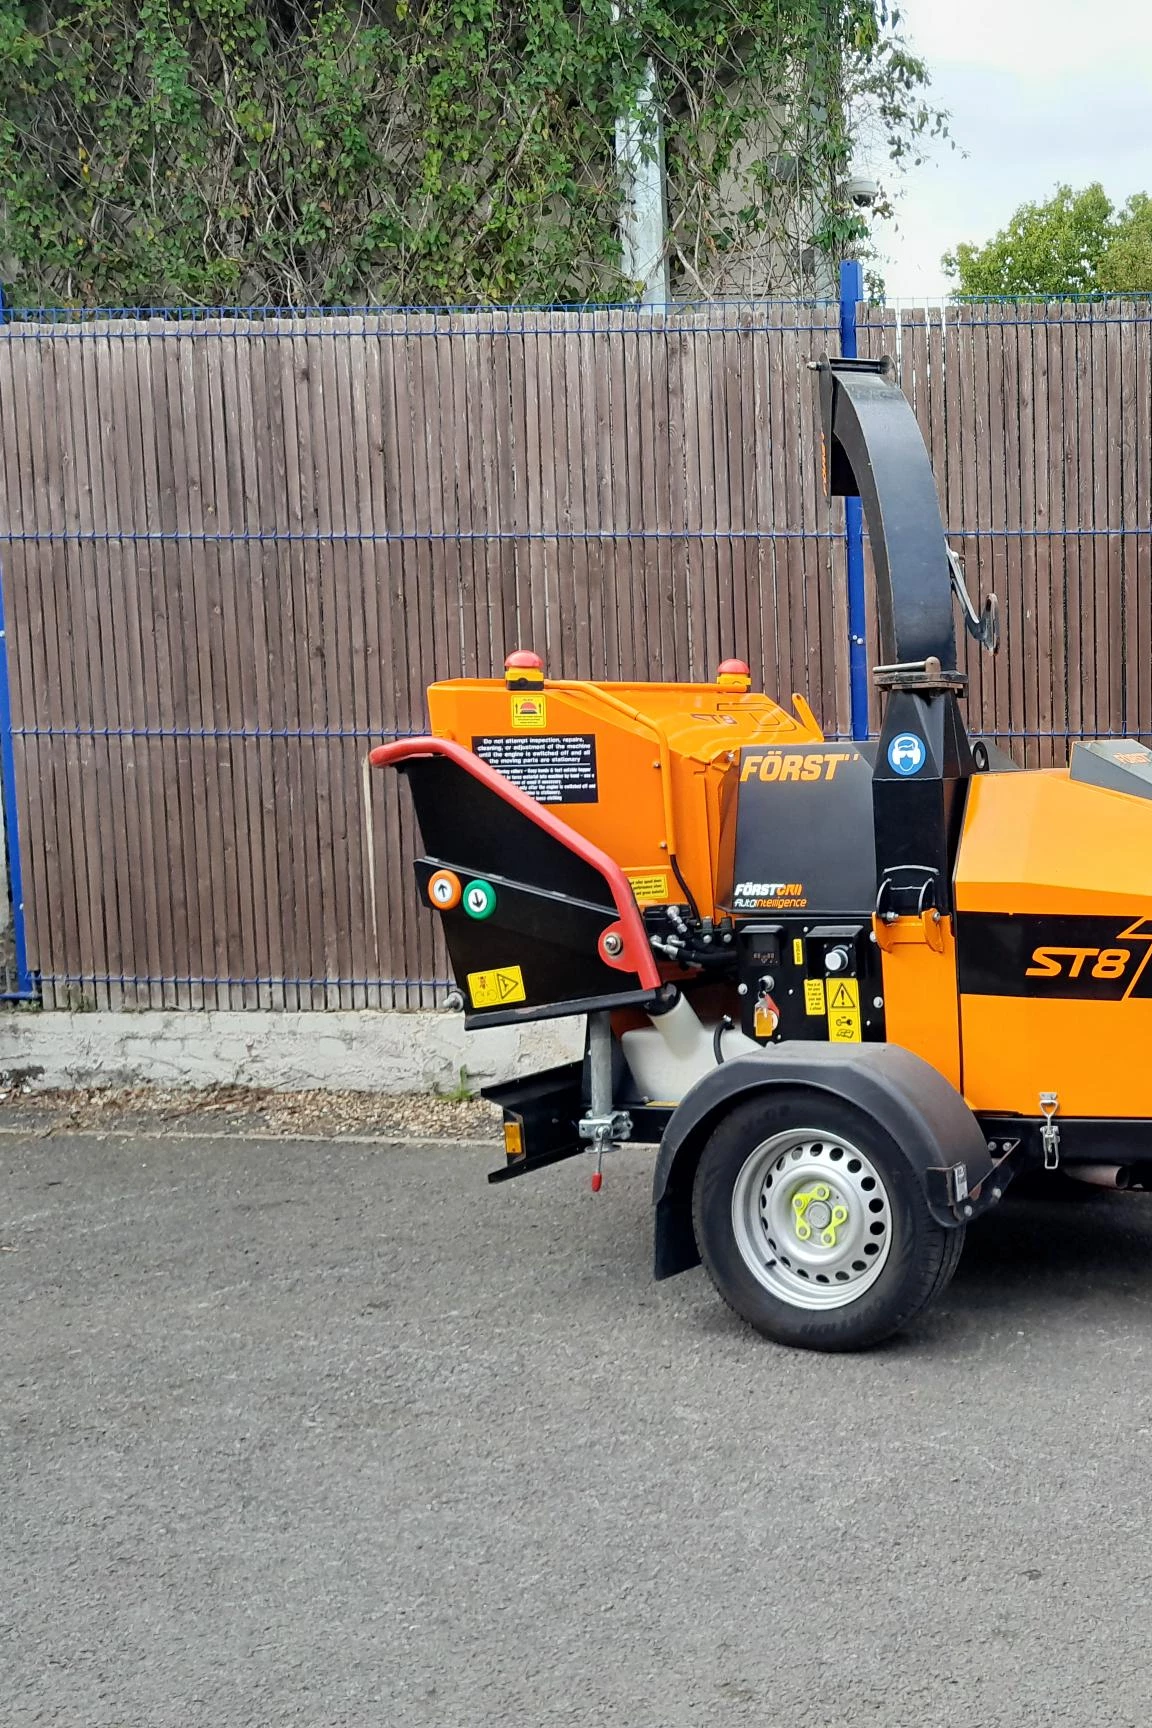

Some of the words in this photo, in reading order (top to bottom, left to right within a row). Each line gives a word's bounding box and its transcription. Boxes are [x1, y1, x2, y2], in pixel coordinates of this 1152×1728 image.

[563, 736, 585, 744] repairs,
[739, 750, 860, 782] FÖRST
[1025, 946, 1131, 979] ST8
